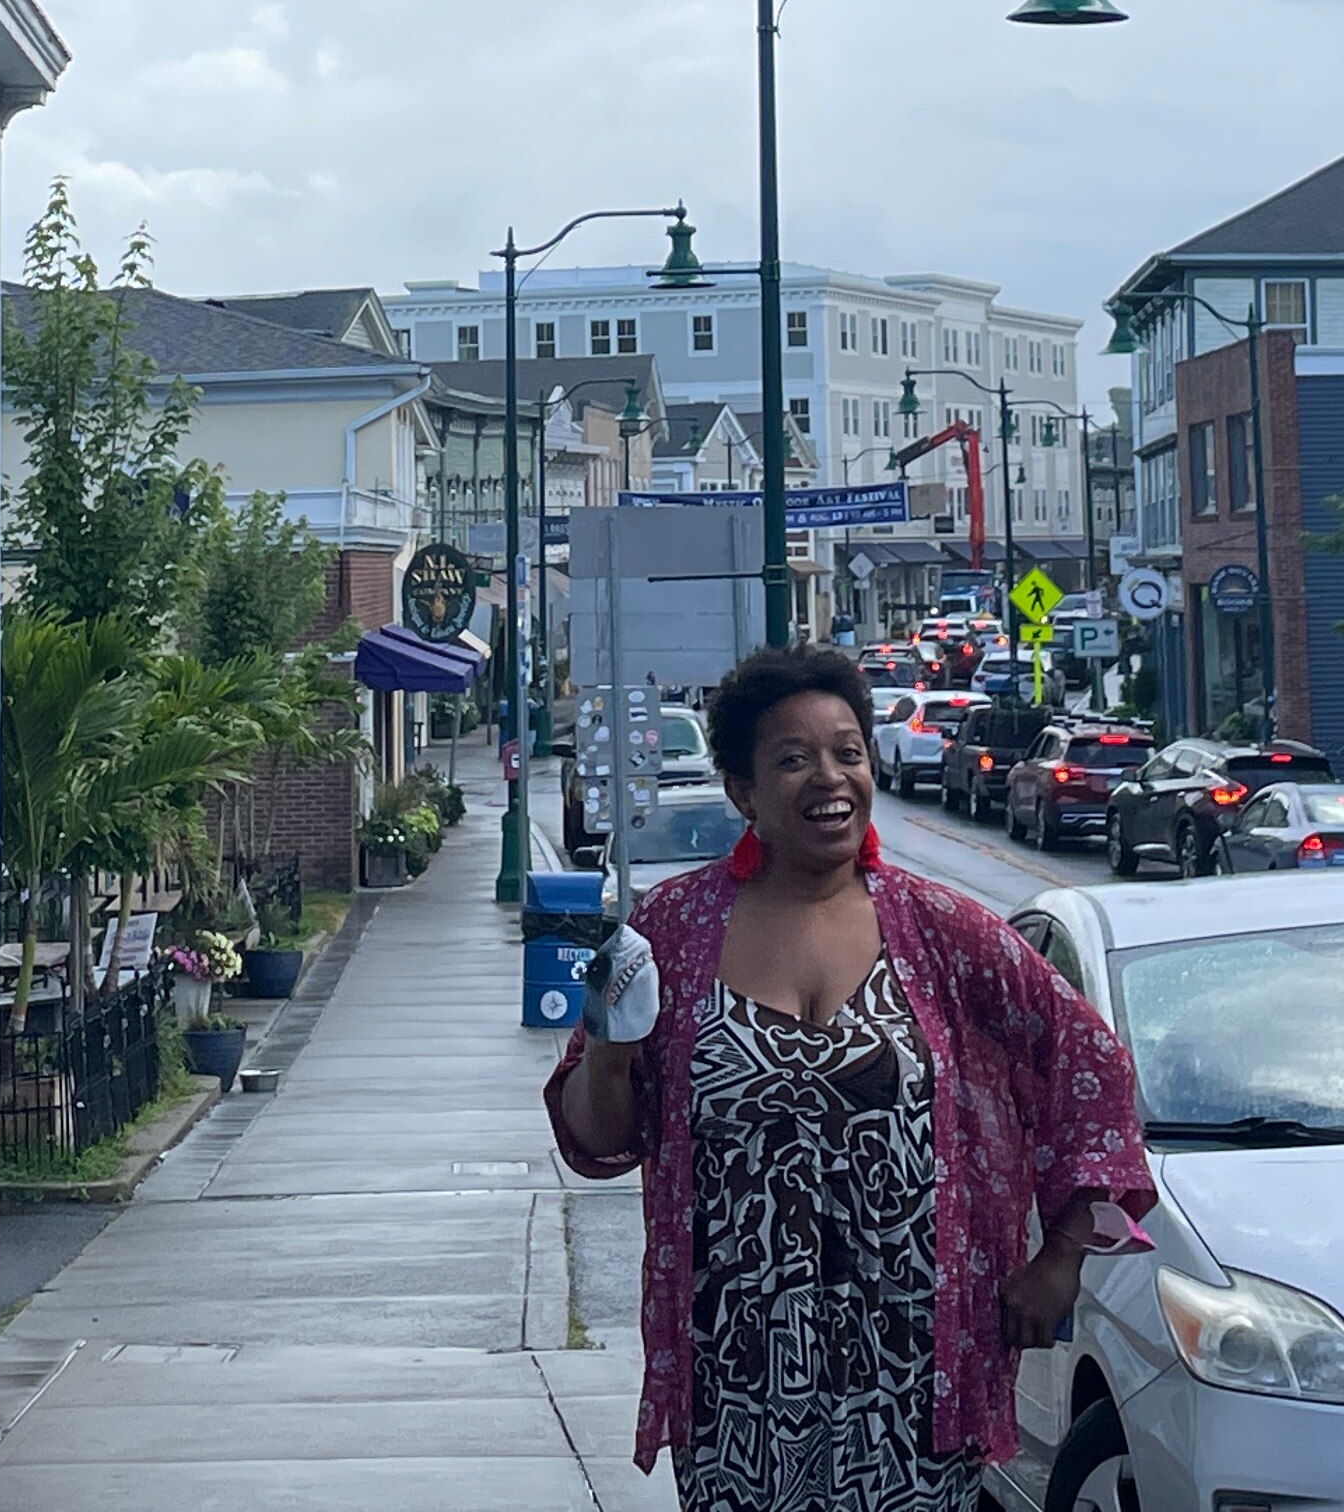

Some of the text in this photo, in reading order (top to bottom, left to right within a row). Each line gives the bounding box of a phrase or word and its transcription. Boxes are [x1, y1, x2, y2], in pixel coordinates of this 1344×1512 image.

[847, 490, 901, 503] FESTIVAL
[411, 568, 465, 585] SHAW
[1131, 581, 1162, 609] Q
[1080, 627, 1098, 651] P
